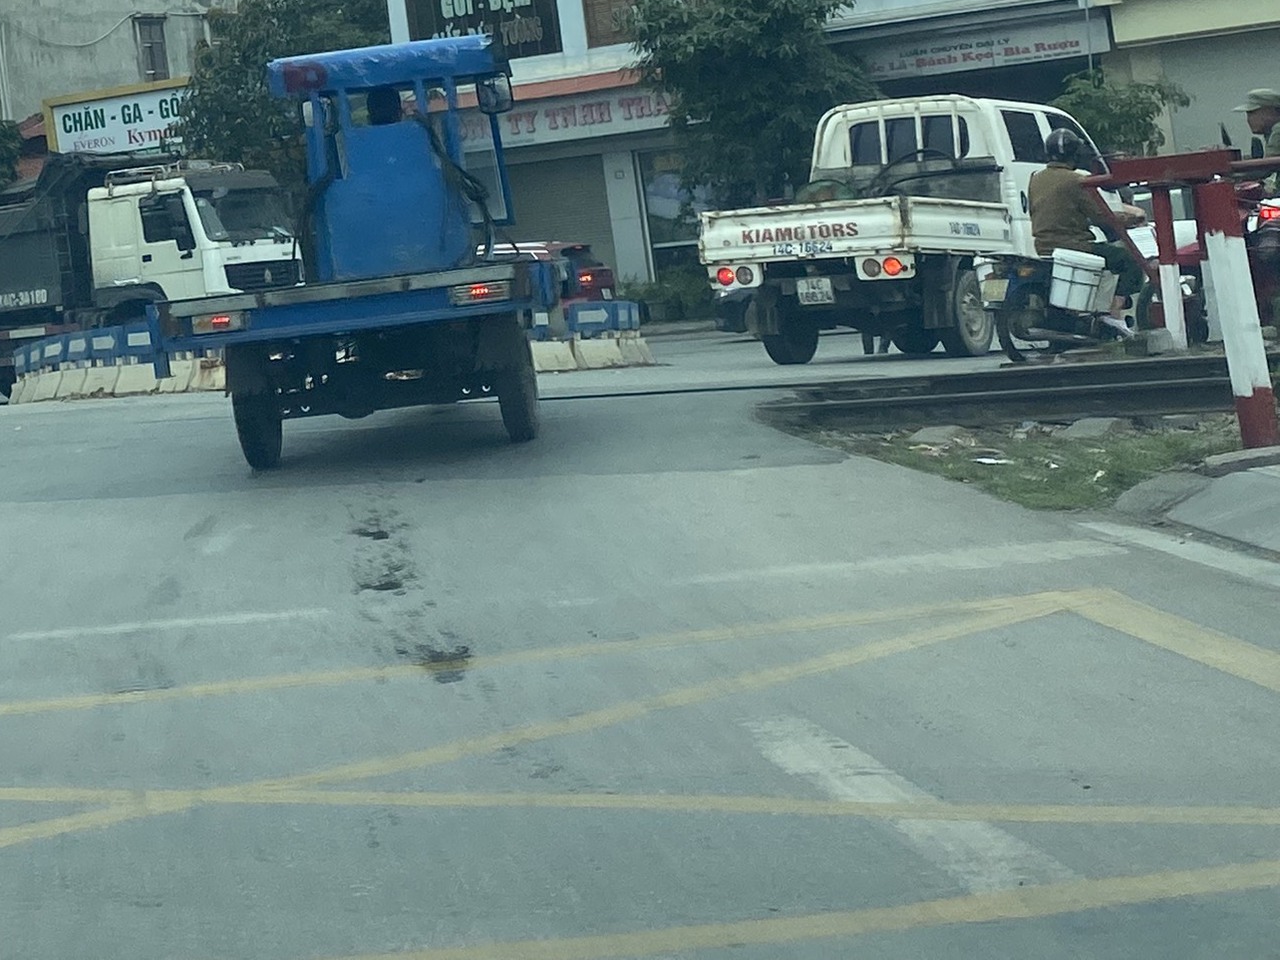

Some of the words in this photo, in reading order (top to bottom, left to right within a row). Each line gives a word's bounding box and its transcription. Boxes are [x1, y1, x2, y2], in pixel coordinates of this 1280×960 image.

[1003, 46, 1031, 57] Bia
[62, 106, 106, 134] CHĂN
[121, 103, 143, 125] GA
[159, 89, 184, 120] GỐ
[507, 110, 538, 135] TY
[544, 100, 612, 130] TNHH
[619, 92, 670, 120] THA
